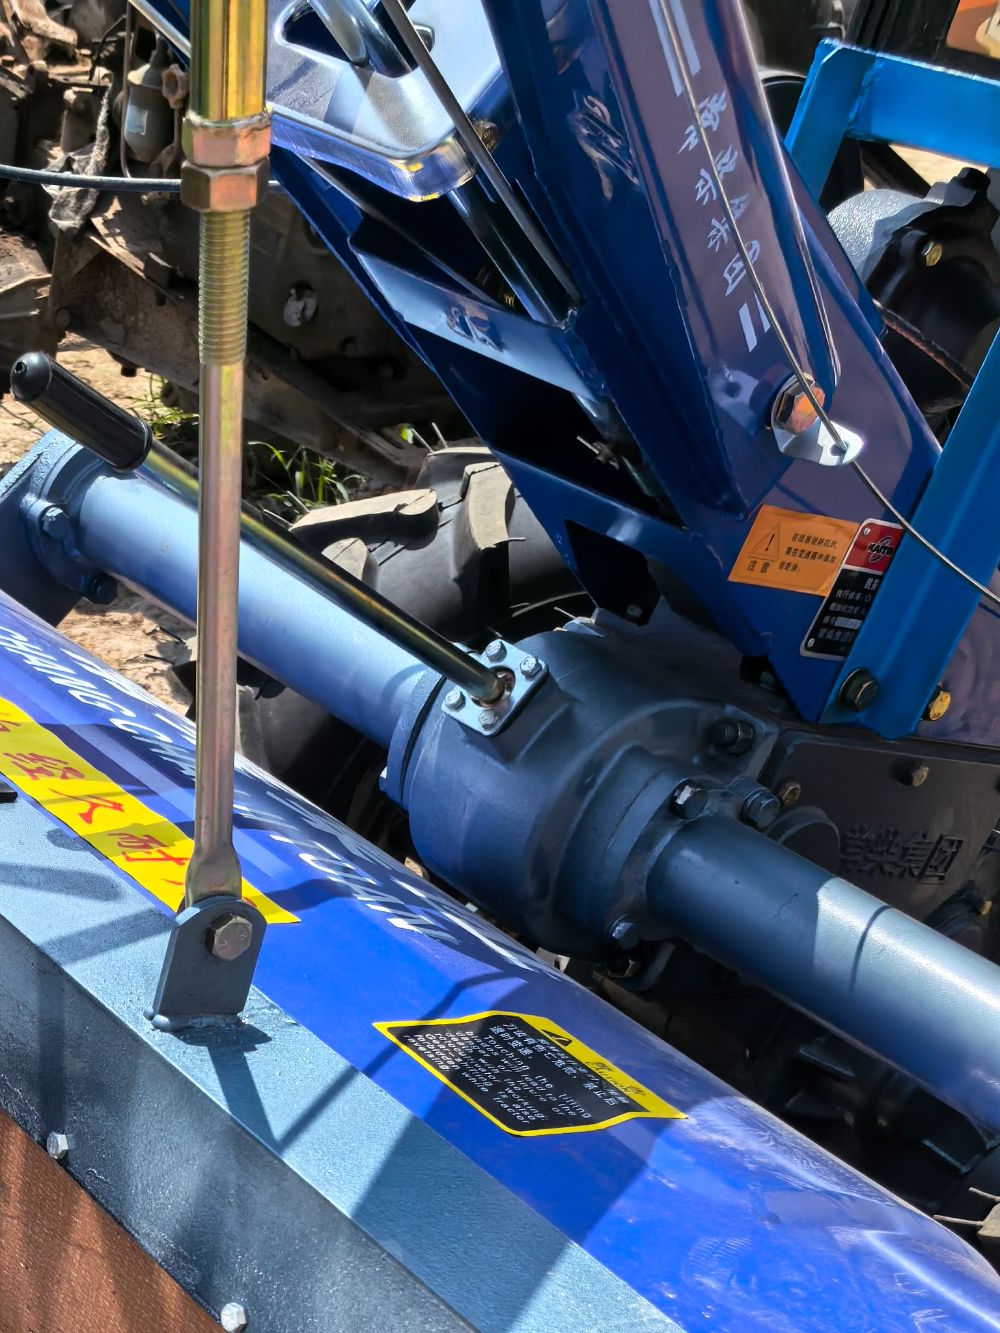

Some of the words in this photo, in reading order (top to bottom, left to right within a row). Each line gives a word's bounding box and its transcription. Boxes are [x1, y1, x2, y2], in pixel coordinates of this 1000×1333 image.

[414, 1034, 460, 1070] forbidden
[462, 1071, 489, 1092] while
[493, 1097, 530, 1123] tractor
[466, 1031, 499, 1056] blades
[558, 1103, 577, 1116] the
[484, 1035, 530, 1070] Touching
[535, 1075, 554, 1089] the
[512, 1104, 535, 1120] also
